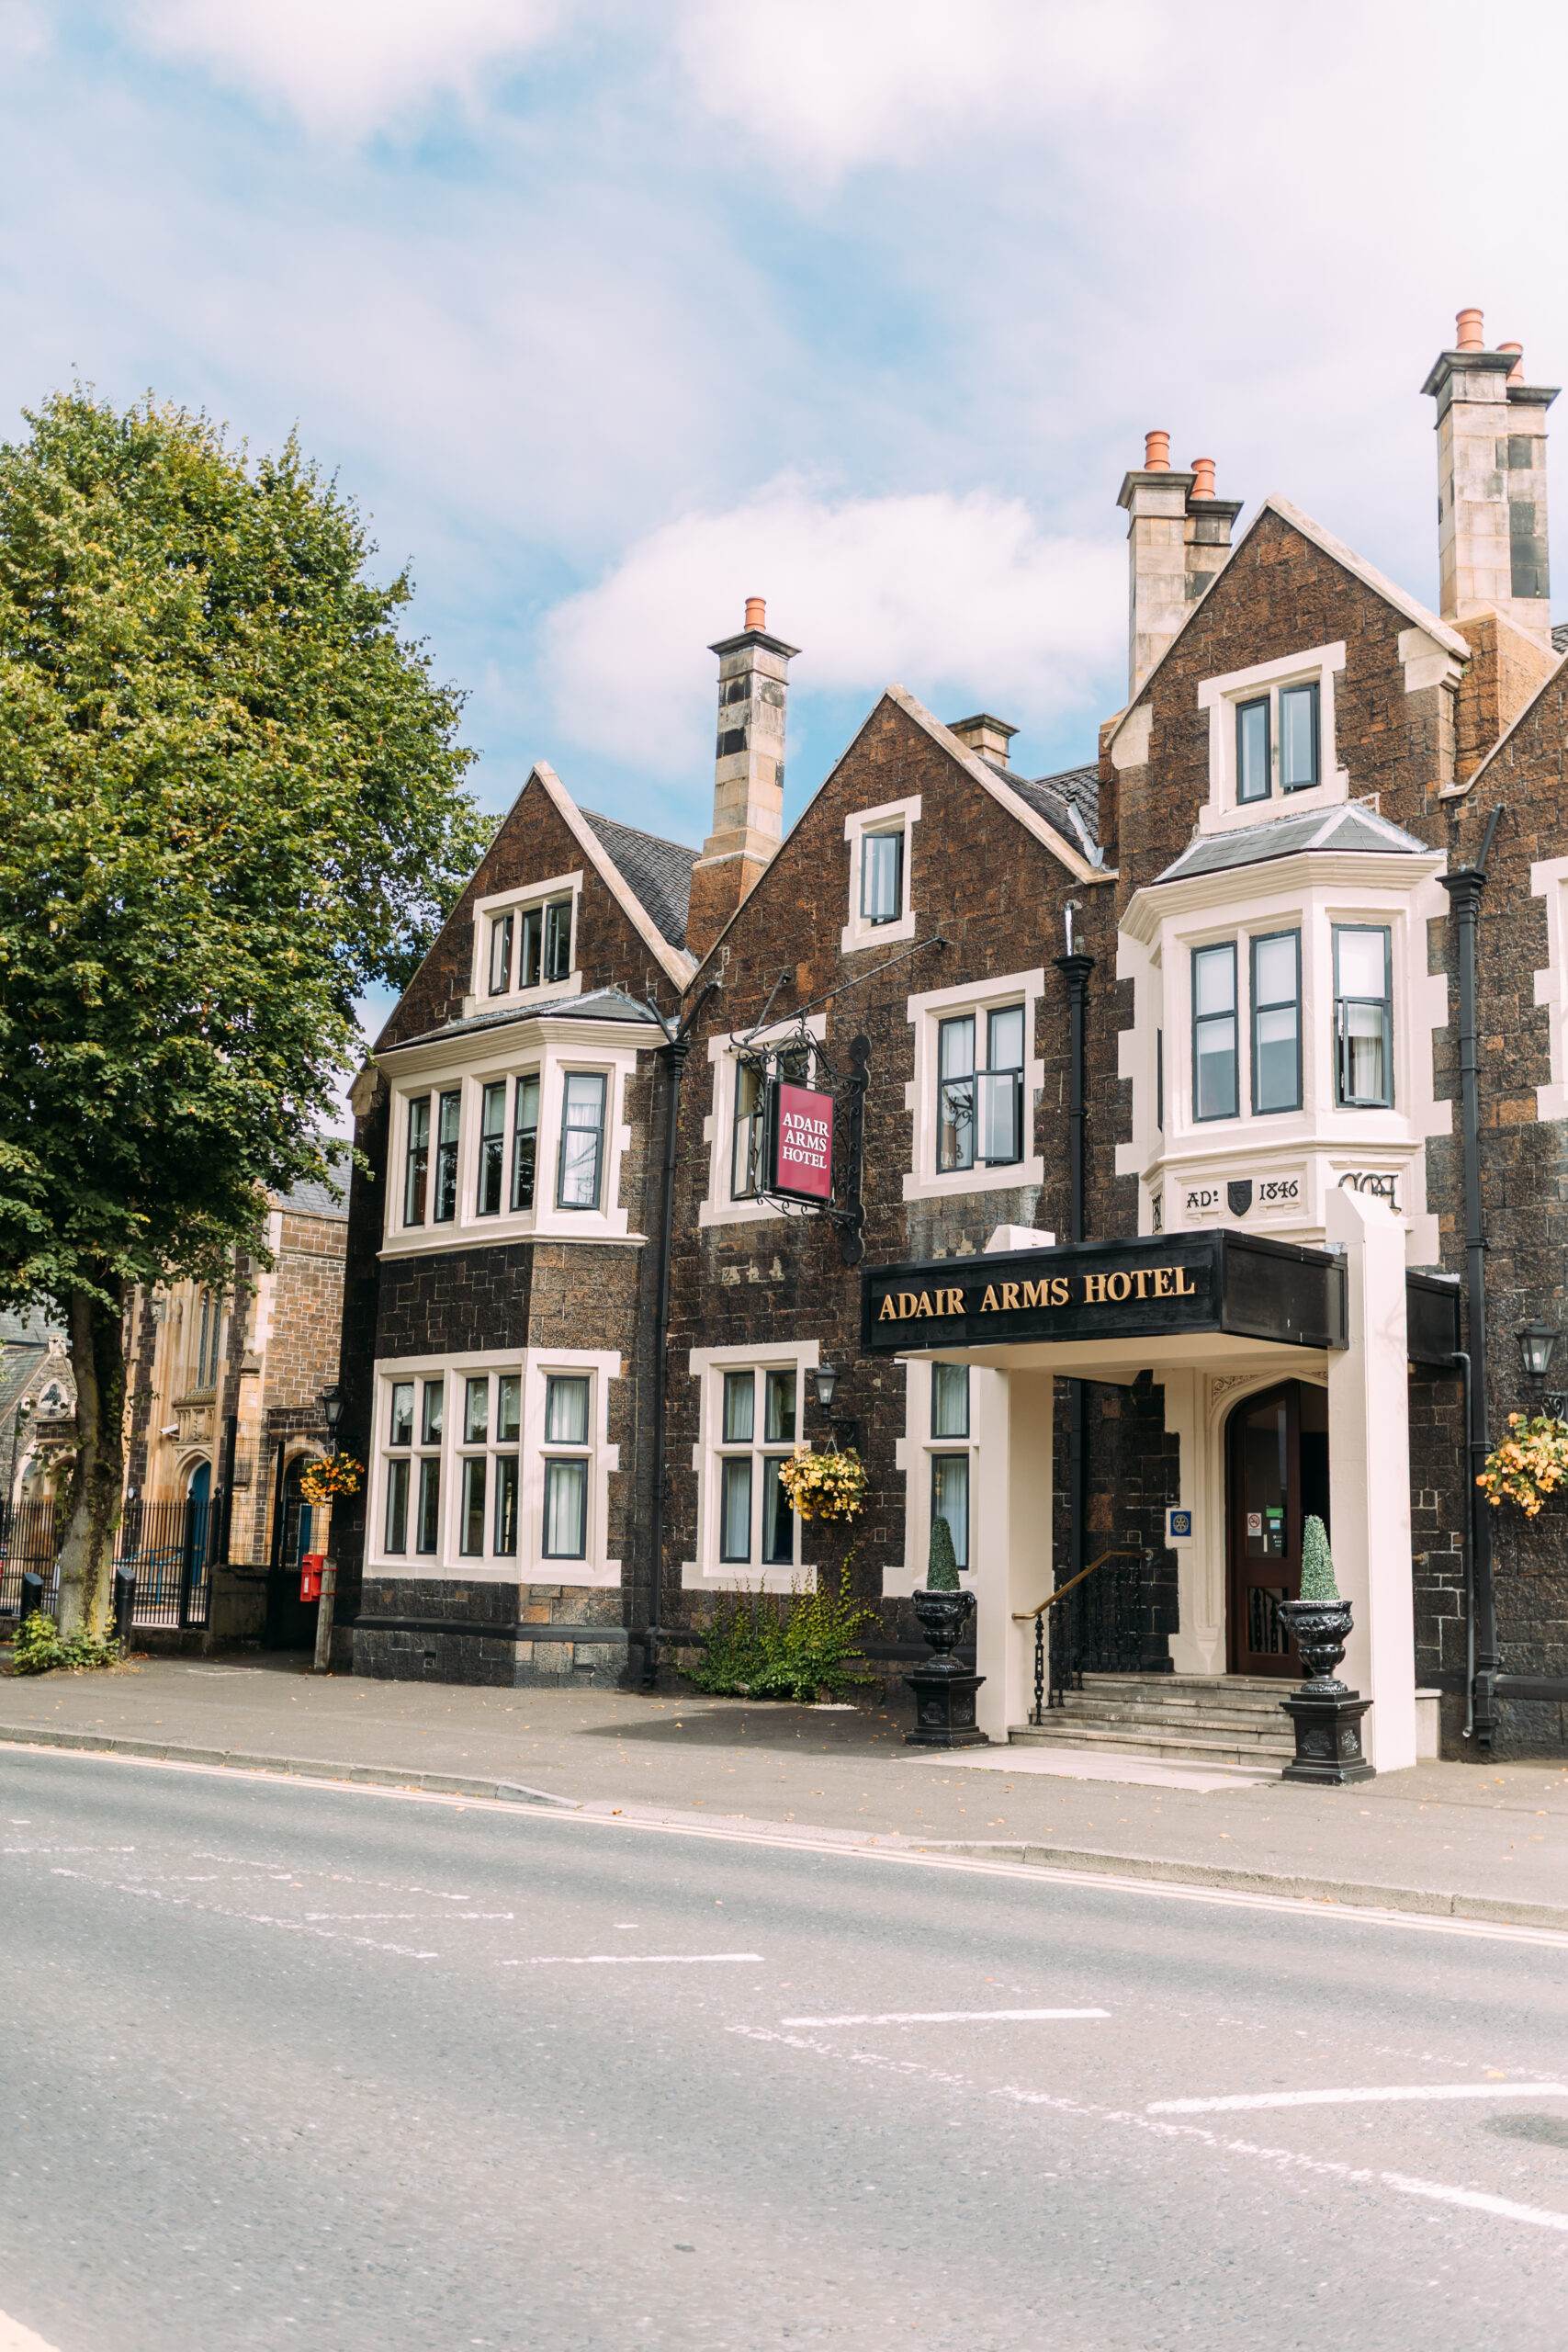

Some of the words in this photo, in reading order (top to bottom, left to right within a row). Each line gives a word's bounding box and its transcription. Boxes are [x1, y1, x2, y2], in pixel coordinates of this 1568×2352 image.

[782, 1112, 829, 1137] ADAIR
[784, 1129, 827, 1152] ARMS
[782, 1146, 828, 1169] HOTEL
[1259, 1180, 1299, 1201] 1846
[878, 1287, 966, 1321] ADAIR
[979, 1277, 1070, 1312] ARMS
[1083, 1266, 1196, 1303] HOTEL
